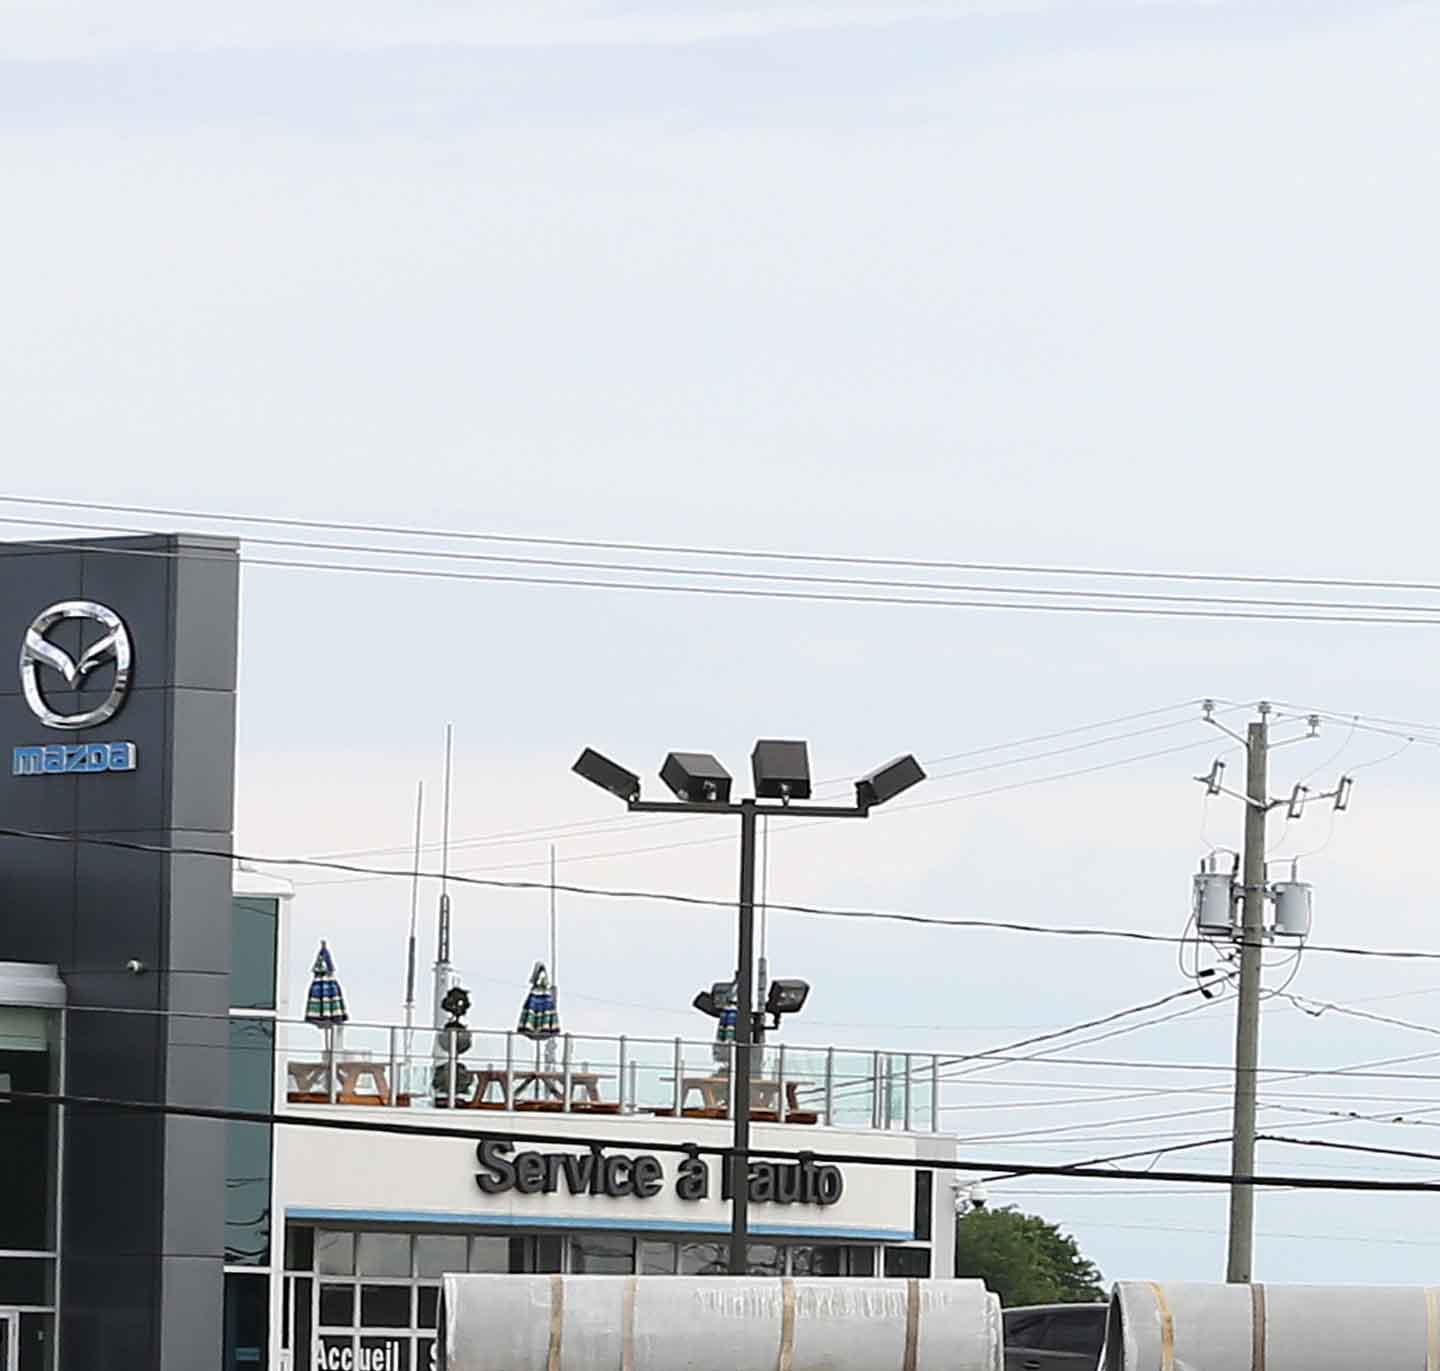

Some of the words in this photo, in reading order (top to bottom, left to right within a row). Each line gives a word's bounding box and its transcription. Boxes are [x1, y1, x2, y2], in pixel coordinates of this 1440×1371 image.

[13, 742, 136, 775] mazda
[476, 1137, 663, 1199] Service
[676, 1142, 708, 1201] à
